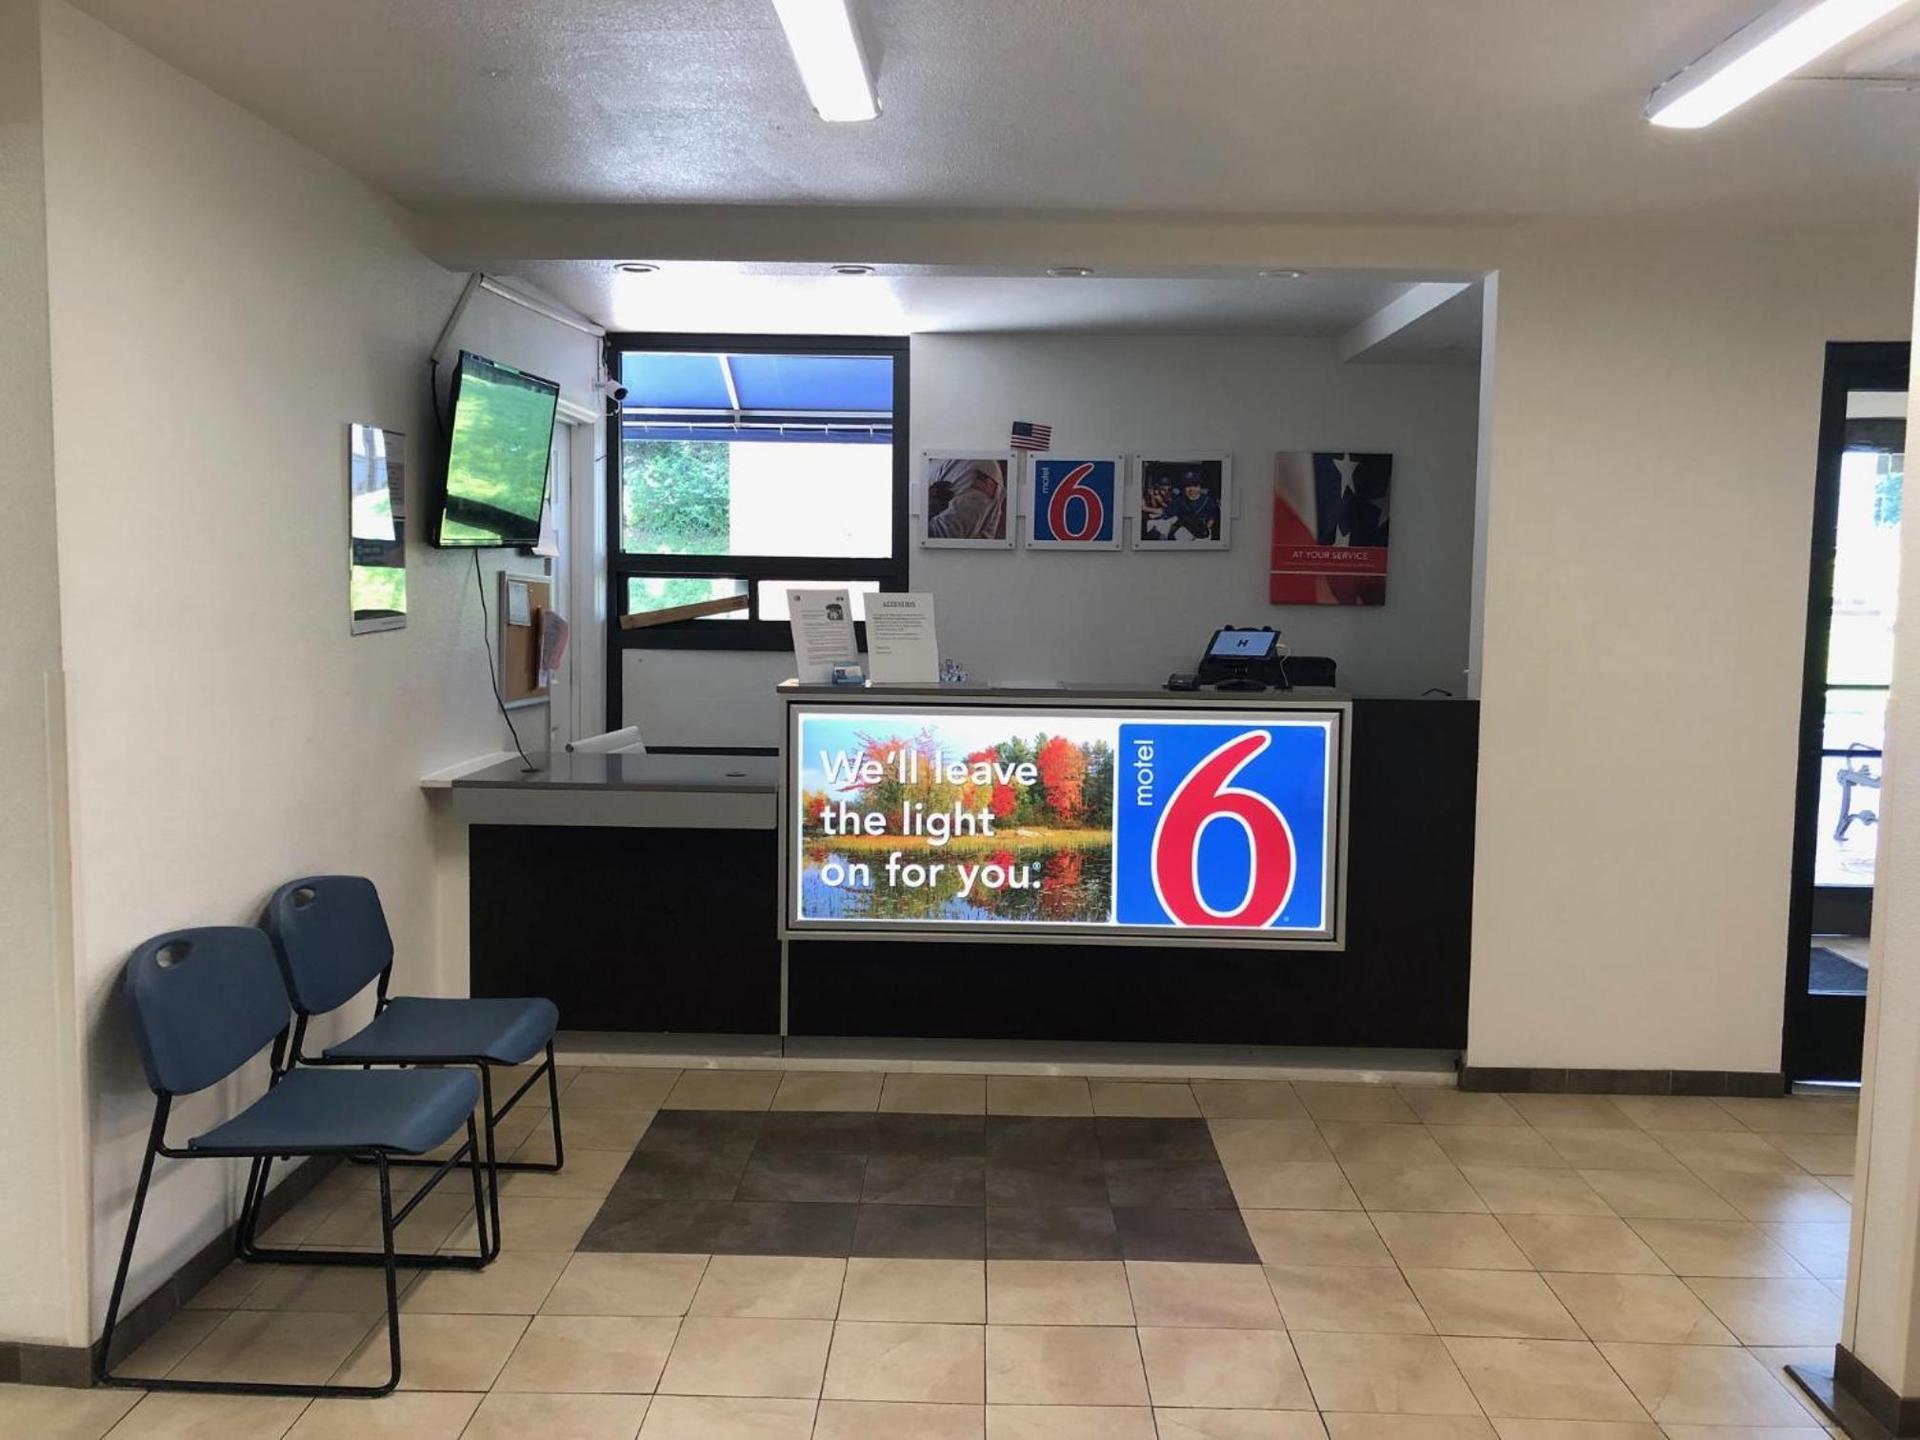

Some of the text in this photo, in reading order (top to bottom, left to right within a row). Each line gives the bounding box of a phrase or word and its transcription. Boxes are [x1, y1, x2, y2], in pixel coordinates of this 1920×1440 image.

[1040, 462, 1104, 541] motel 6
[1292, 550, 1369, 561] AT YOUR SERVICE
[819, 749, 1039, 786] We'll leave
[819, 801, 995, 847] the light
[1134, 729, 1298, 929] motel 6
[820, 861, 871, 889] on
[886, 853, 944, 889] for
